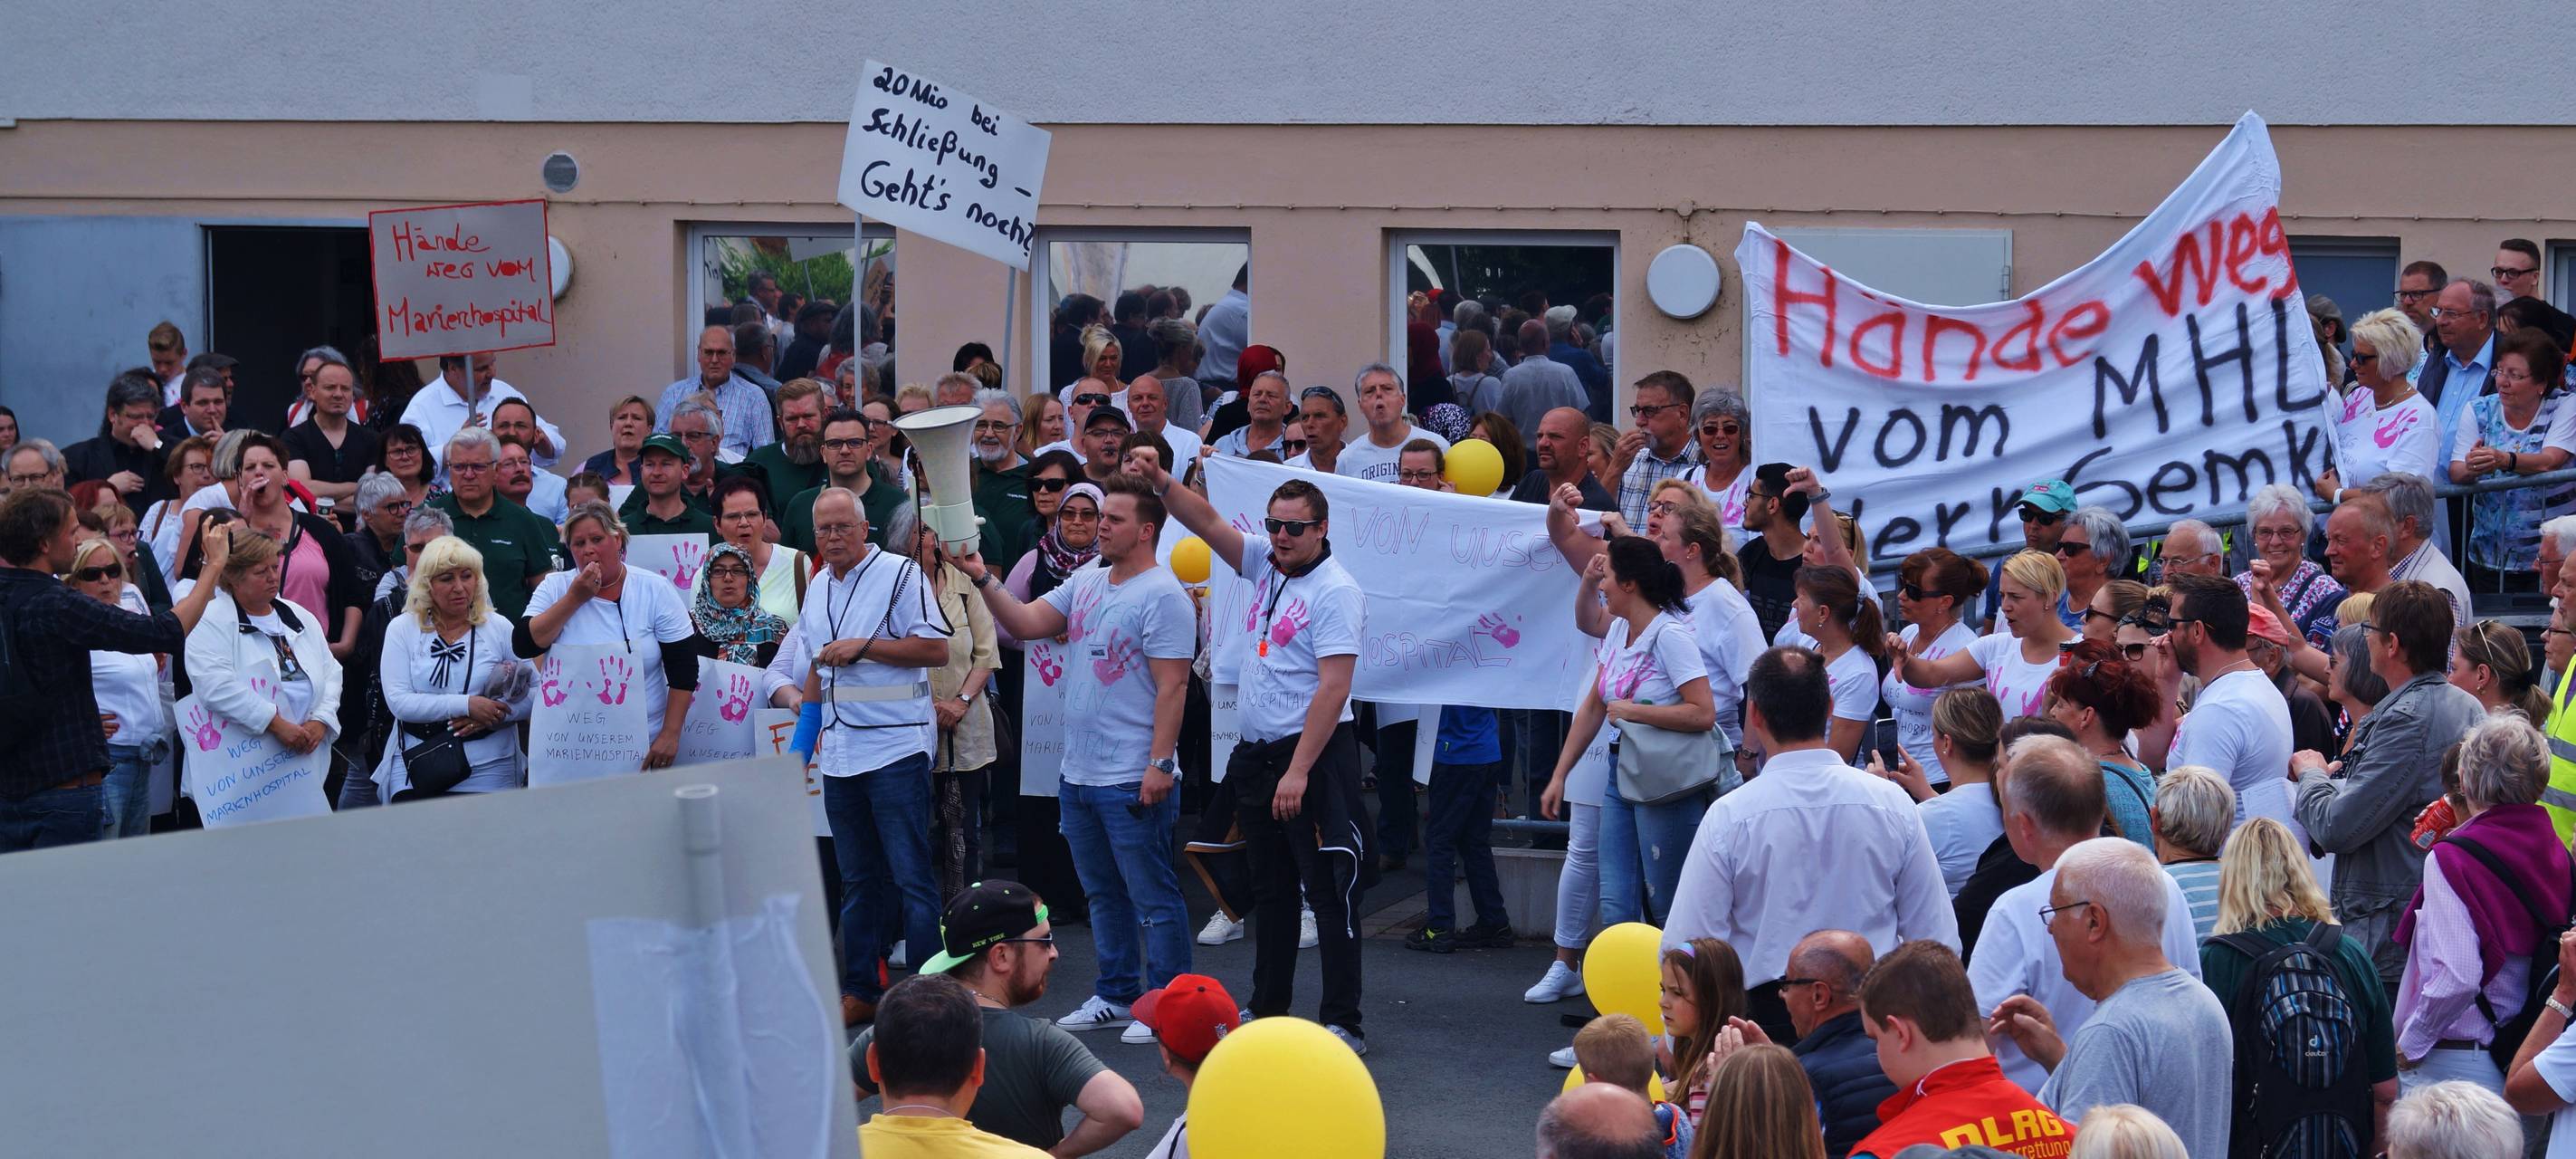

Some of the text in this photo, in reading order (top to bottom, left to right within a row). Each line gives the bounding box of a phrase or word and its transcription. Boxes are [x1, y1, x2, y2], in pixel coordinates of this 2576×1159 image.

[873, 67, 1000, 136] 20 Mio bei
[863, 108, 998, 188] Schließung
[861, 160, 1035, 257] Geht's noch?
[392, 221, 491, 261] Hände
[388, 297, 551, 339] Marienhospital
[1774, 238, 2110, 383] Hände
[1808, 297, 2326, 474] vom MHL
[1361, 463, 1401, 480] ORIGIN
[1351, 506, 1563, 571] VON UNSE
[567, 712, 606, 725] WEG
[1030, 714, 1053, 726] VON
[1217, 701, 1237, 710] UNS
[546, 732, 634, 744] VON UNSEREM
[683, 719, 720, 735] WEG
[227, 737, 262, 759] WEG
[546, 748, 646, 761] MARIENHOSPITAL
[689, 748, 752, 761] UNSEREM
[1025, 740, 1064, 754] MARIE
[206, 749, 296, 797] VON UNSERE
[206, 768, 312, 824] MARIENHOSPITAL
[972, 933, 1006, 948] NEW YORK
[1940, 1109, 2065, 1151] DLRG
